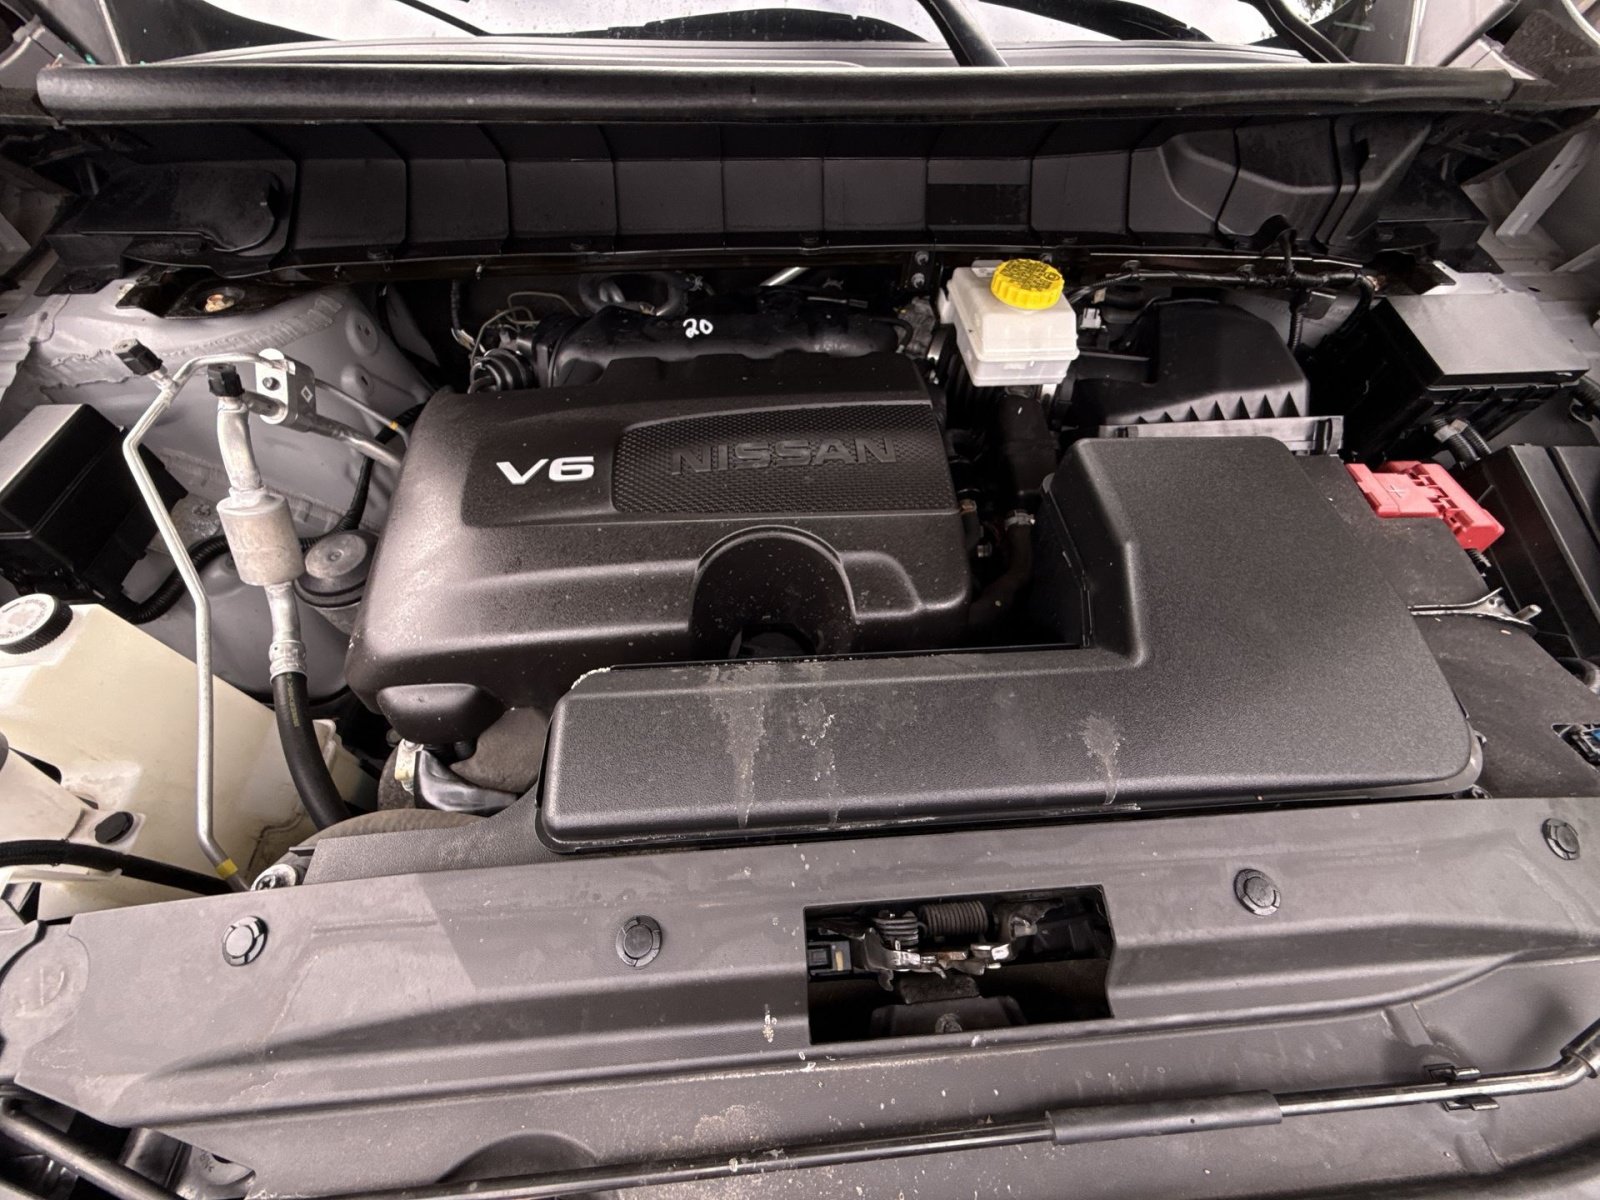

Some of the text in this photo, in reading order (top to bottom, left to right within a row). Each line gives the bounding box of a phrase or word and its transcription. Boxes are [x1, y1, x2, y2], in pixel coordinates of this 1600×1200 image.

[683, 318, 714, 339] 20
[496, 456, 595, 485] V6
[671, 437, 897, 476] NISSAN
